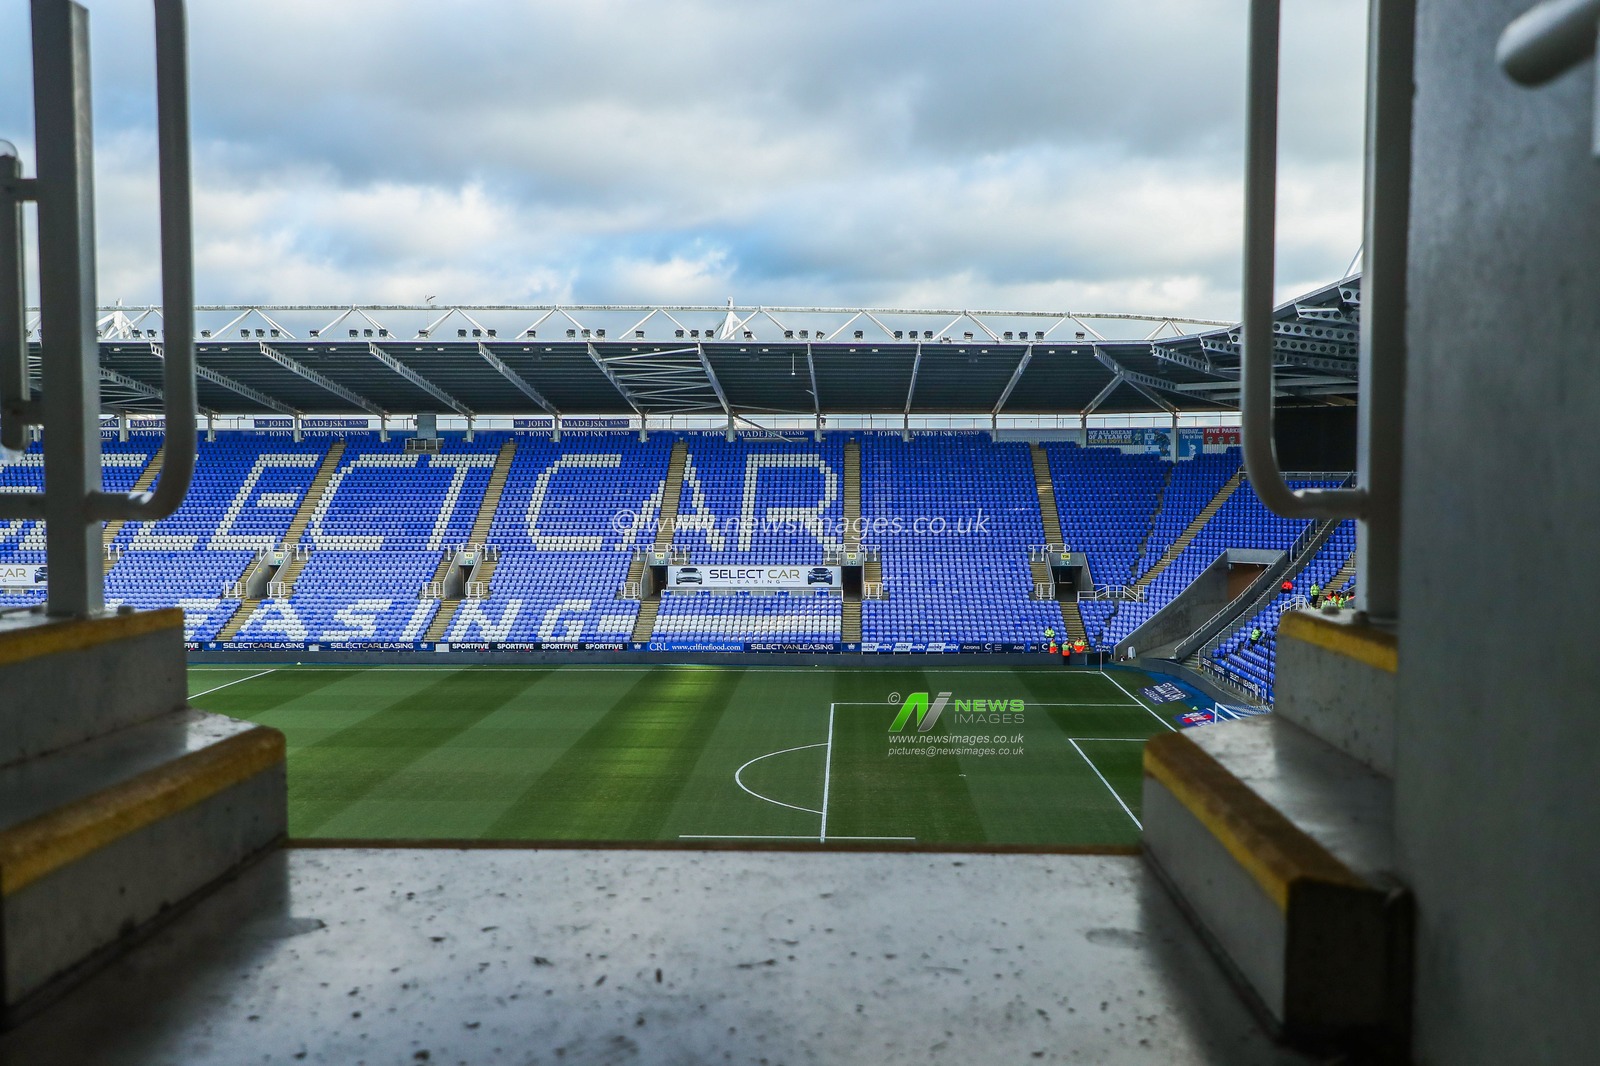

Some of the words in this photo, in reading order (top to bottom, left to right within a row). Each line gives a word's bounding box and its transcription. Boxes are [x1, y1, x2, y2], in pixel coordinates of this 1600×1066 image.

[709, 569, 764, 579] SELECT
[767, 569, 800, 579] CAR
[649, 643, 669, 651] CRL
[671, 643, 741, 651] www.crlfireflood.com
[750, 643, 834, 651] SELECTVANLEASING
